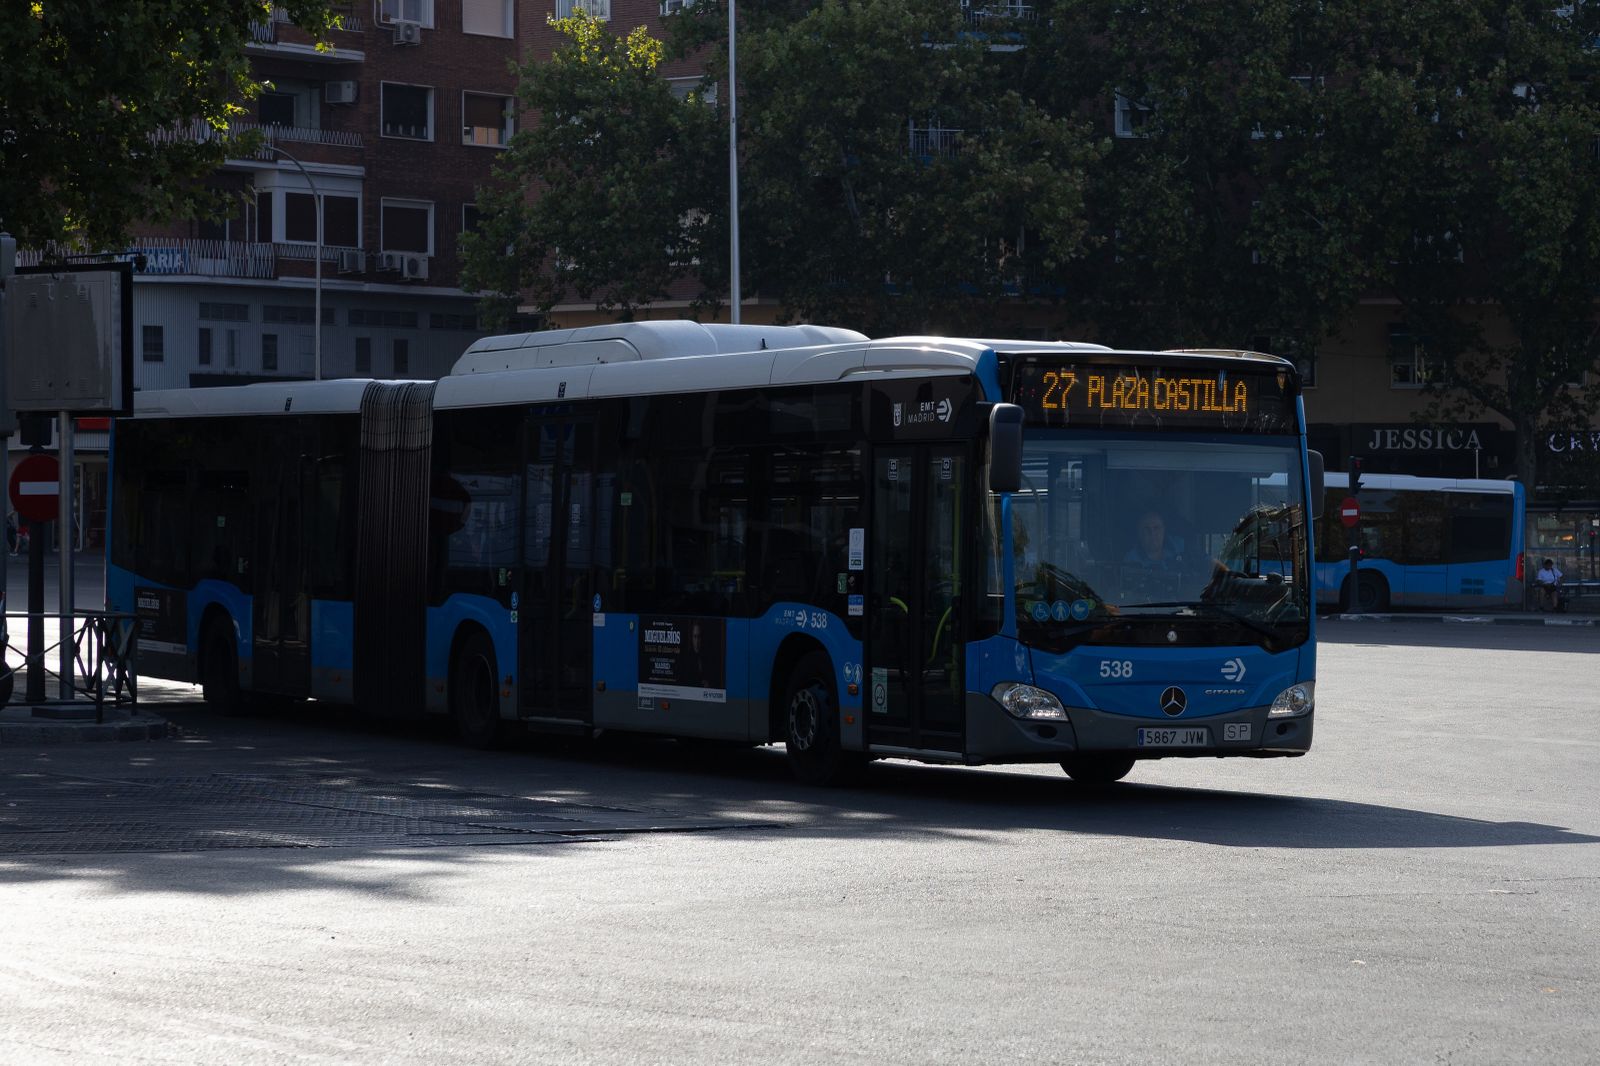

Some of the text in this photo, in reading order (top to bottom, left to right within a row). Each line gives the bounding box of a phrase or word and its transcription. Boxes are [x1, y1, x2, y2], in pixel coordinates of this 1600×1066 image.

[1042, 371, 1248, 412] 27 PLAZA CASTILLA
[920, 401, 935, 412] EMT
[907, 412, 935, 424] MADRID
[1368, 428, 1483, 451] JESSICA
[810, 612, 828, 629] 538
[1099, 660, 1134, 679] 538
[1146, 731, 1205, 745] 5867 JVM
[1226, 725, 1249, 739] SP
